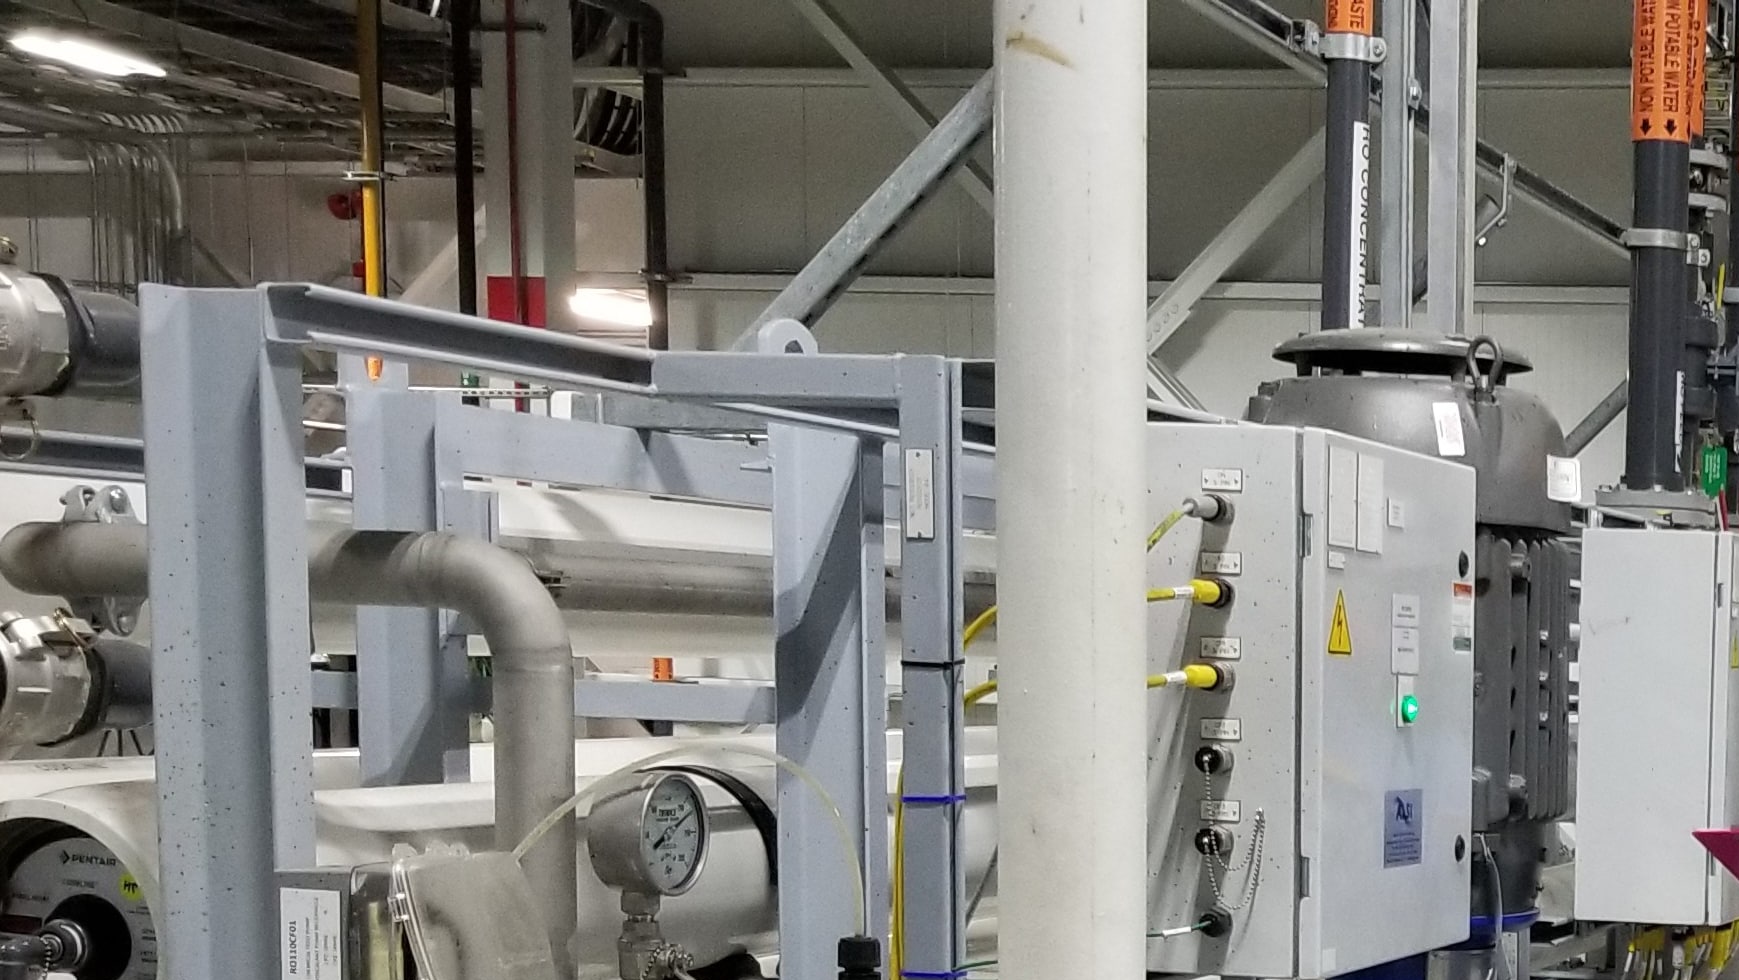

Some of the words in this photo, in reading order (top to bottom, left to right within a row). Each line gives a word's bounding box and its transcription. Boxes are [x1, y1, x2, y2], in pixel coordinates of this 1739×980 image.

[1664, 13, 1680, 67] POTABLE
[1664, 71, 1679, 112] WATER
[71, 853, 117, 866] PENTAIR
